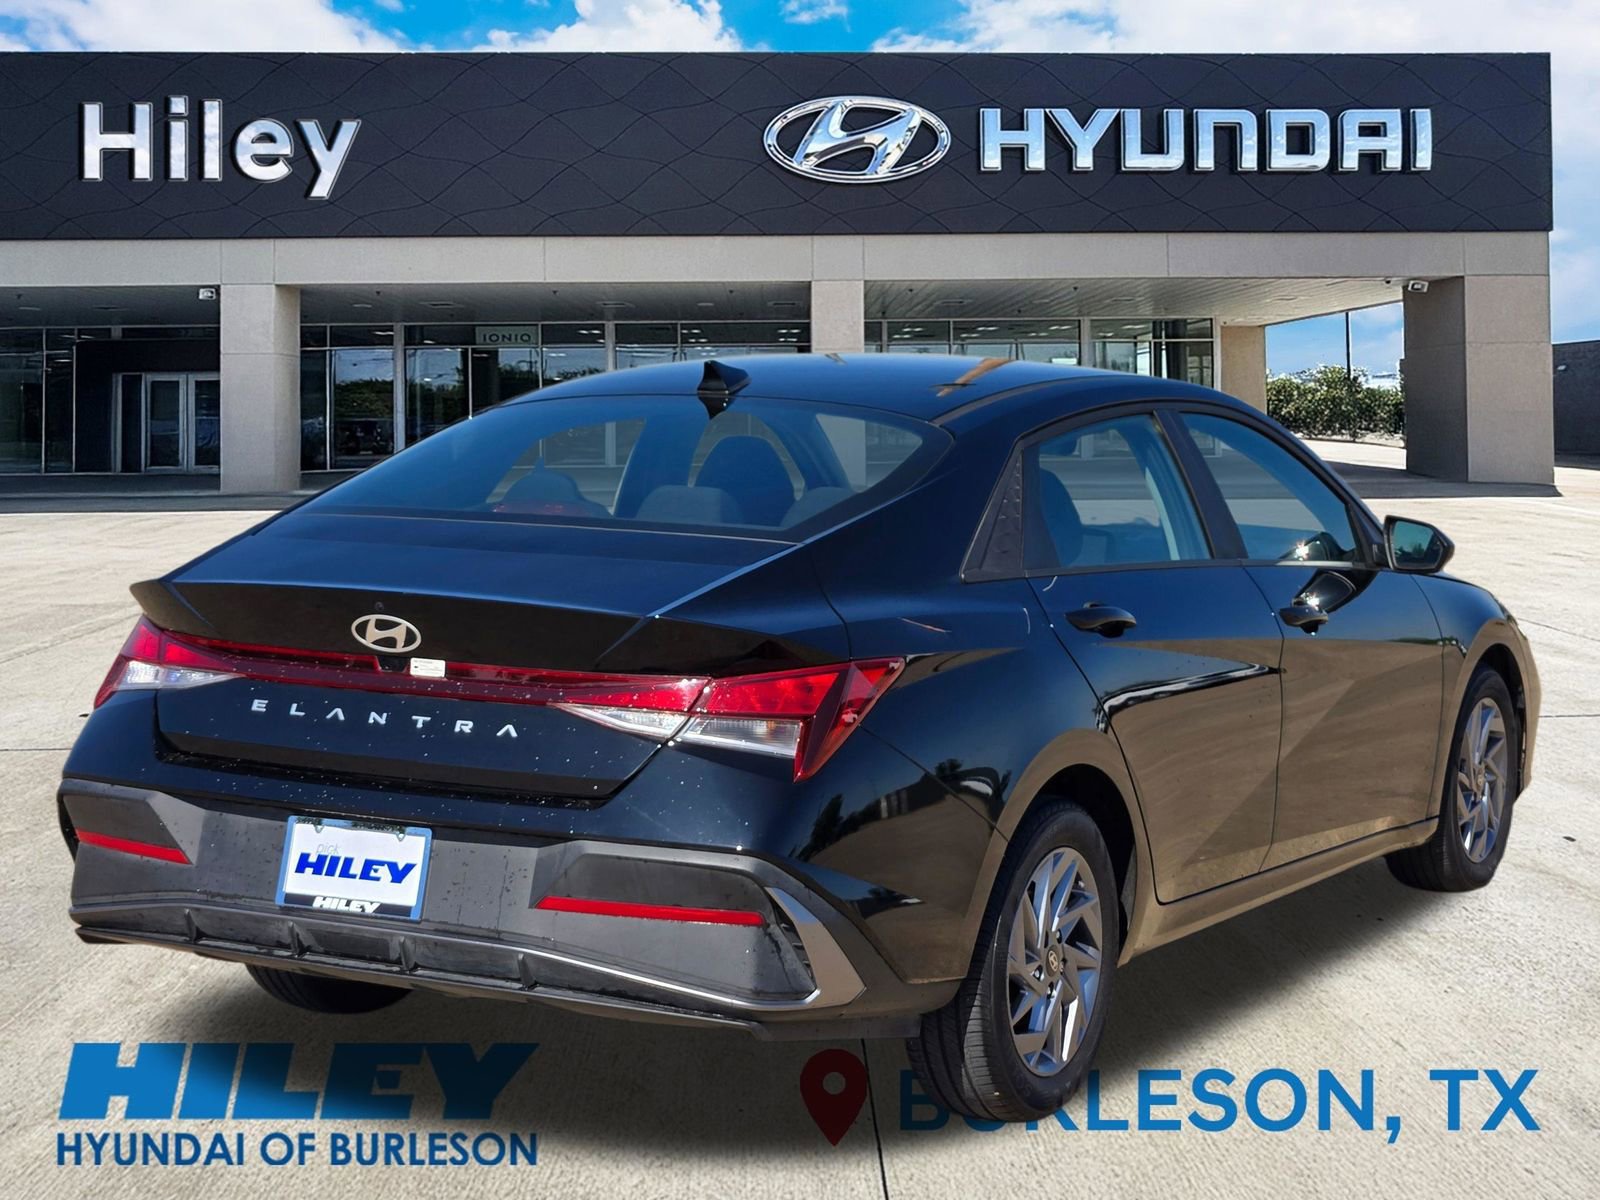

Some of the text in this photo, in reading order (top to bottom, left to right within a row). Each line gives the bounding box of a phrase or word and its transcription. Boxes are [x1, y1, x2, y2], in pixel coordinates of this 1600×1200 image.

[80, 95, 361, 200] Hiley
[979, 107, 1431, 172] HYUNDAI
[250, 698, 519, 738] ELANTRA
[294, 852, 418, 884] HILEY
[312, 895, 381, 914] HILEY
